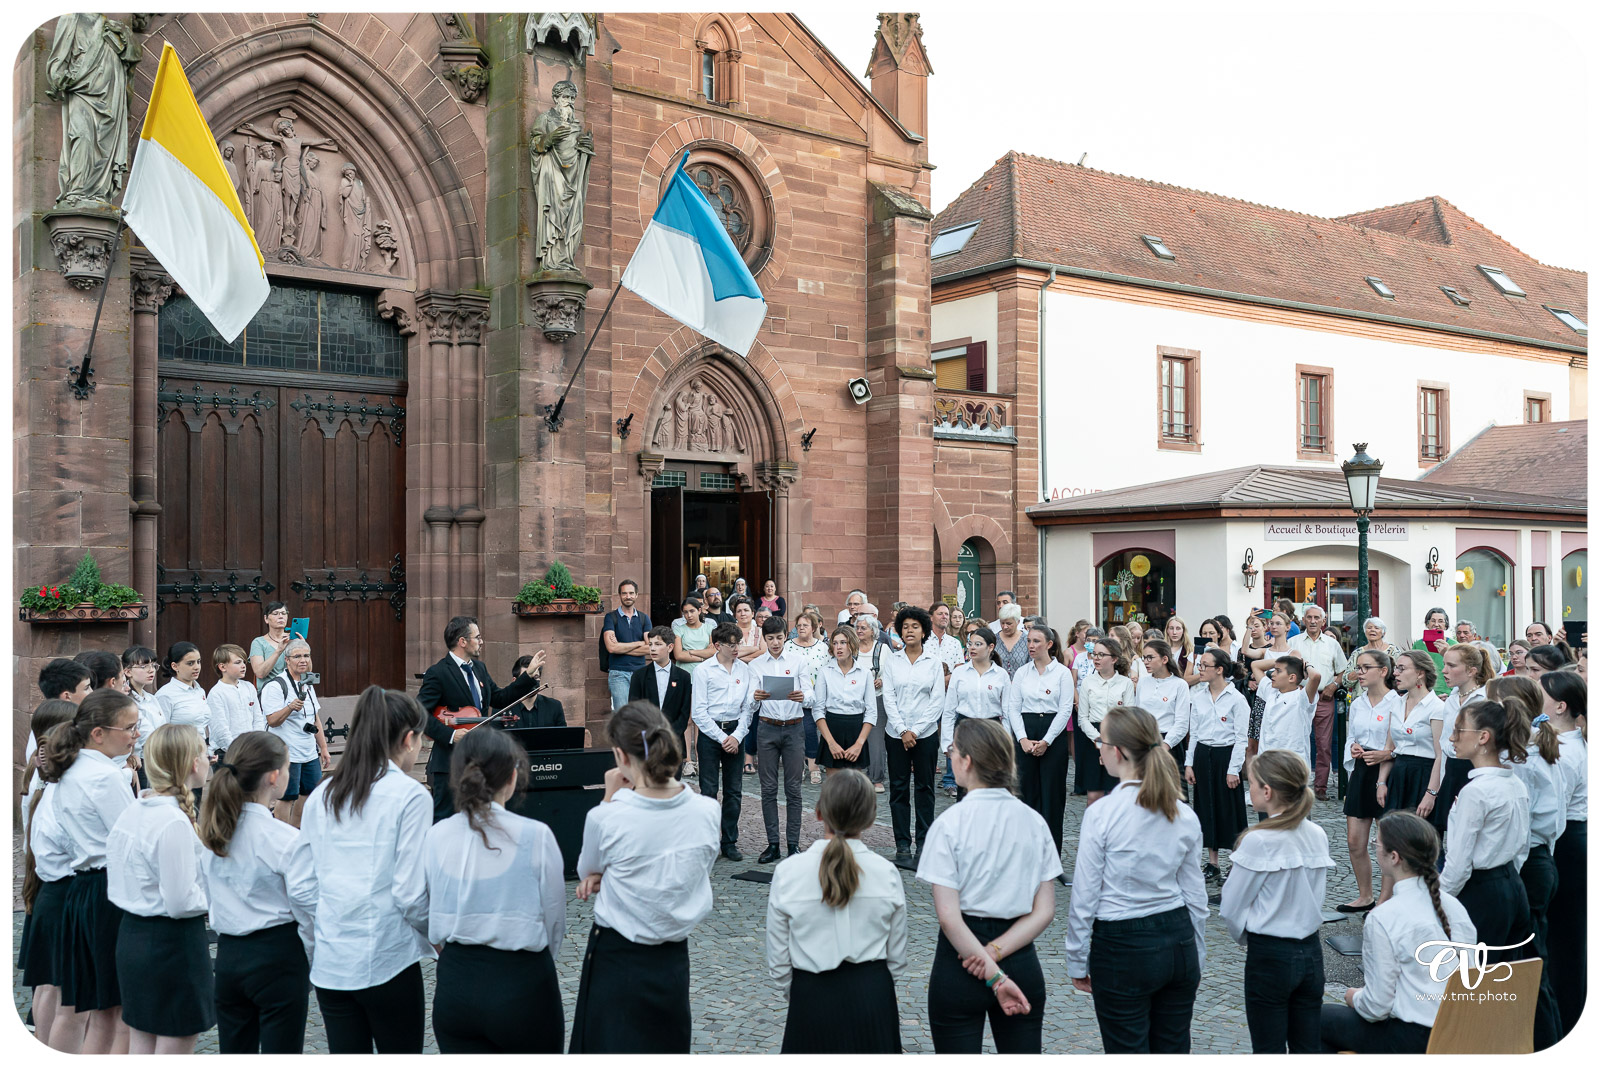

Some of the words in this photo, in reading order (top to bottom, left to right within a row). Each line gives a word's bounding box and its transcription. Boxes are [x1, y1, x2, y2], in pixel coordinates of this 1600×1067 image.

[1268, 523, 1302, 534] Accueil
[1304, 524, 1313, 534] &
[1315, 524, 1357, 537] Boutique
[1374, 523, 1406, 534] Pèlerin
[531, 763, 562, 772] CASIO
